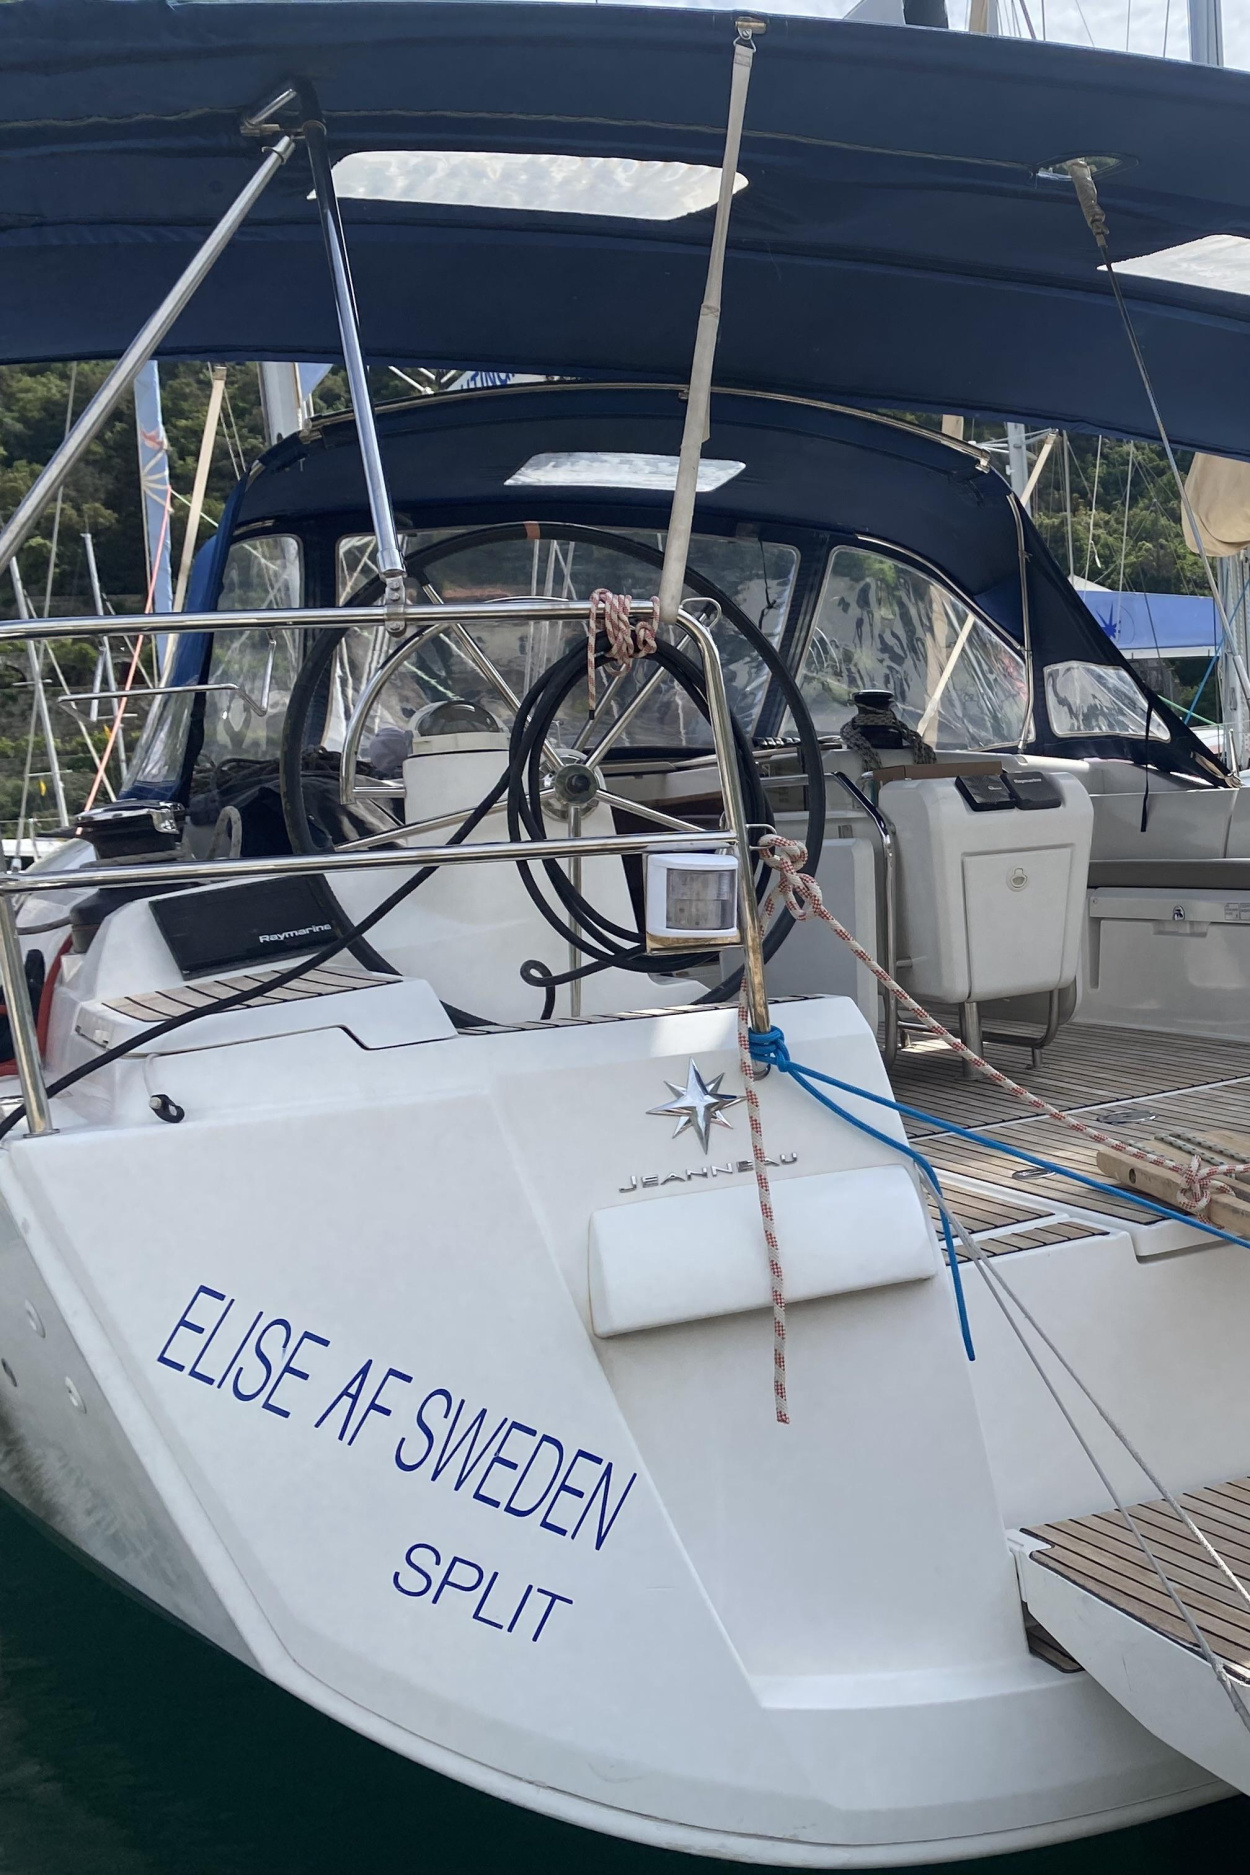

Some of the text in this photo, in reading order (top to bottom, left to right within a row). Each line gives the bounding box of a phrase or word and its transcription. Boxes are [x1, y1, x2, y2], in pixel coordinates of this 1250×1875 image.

[258, 924, 332, 943] Raymarine
[618, 1152, 798, 1193] JEANNEAU
[157, 1285, 637, 1551] ELISE AF SWEDEN
[393, 1543, 573, 1642] SPLIT
